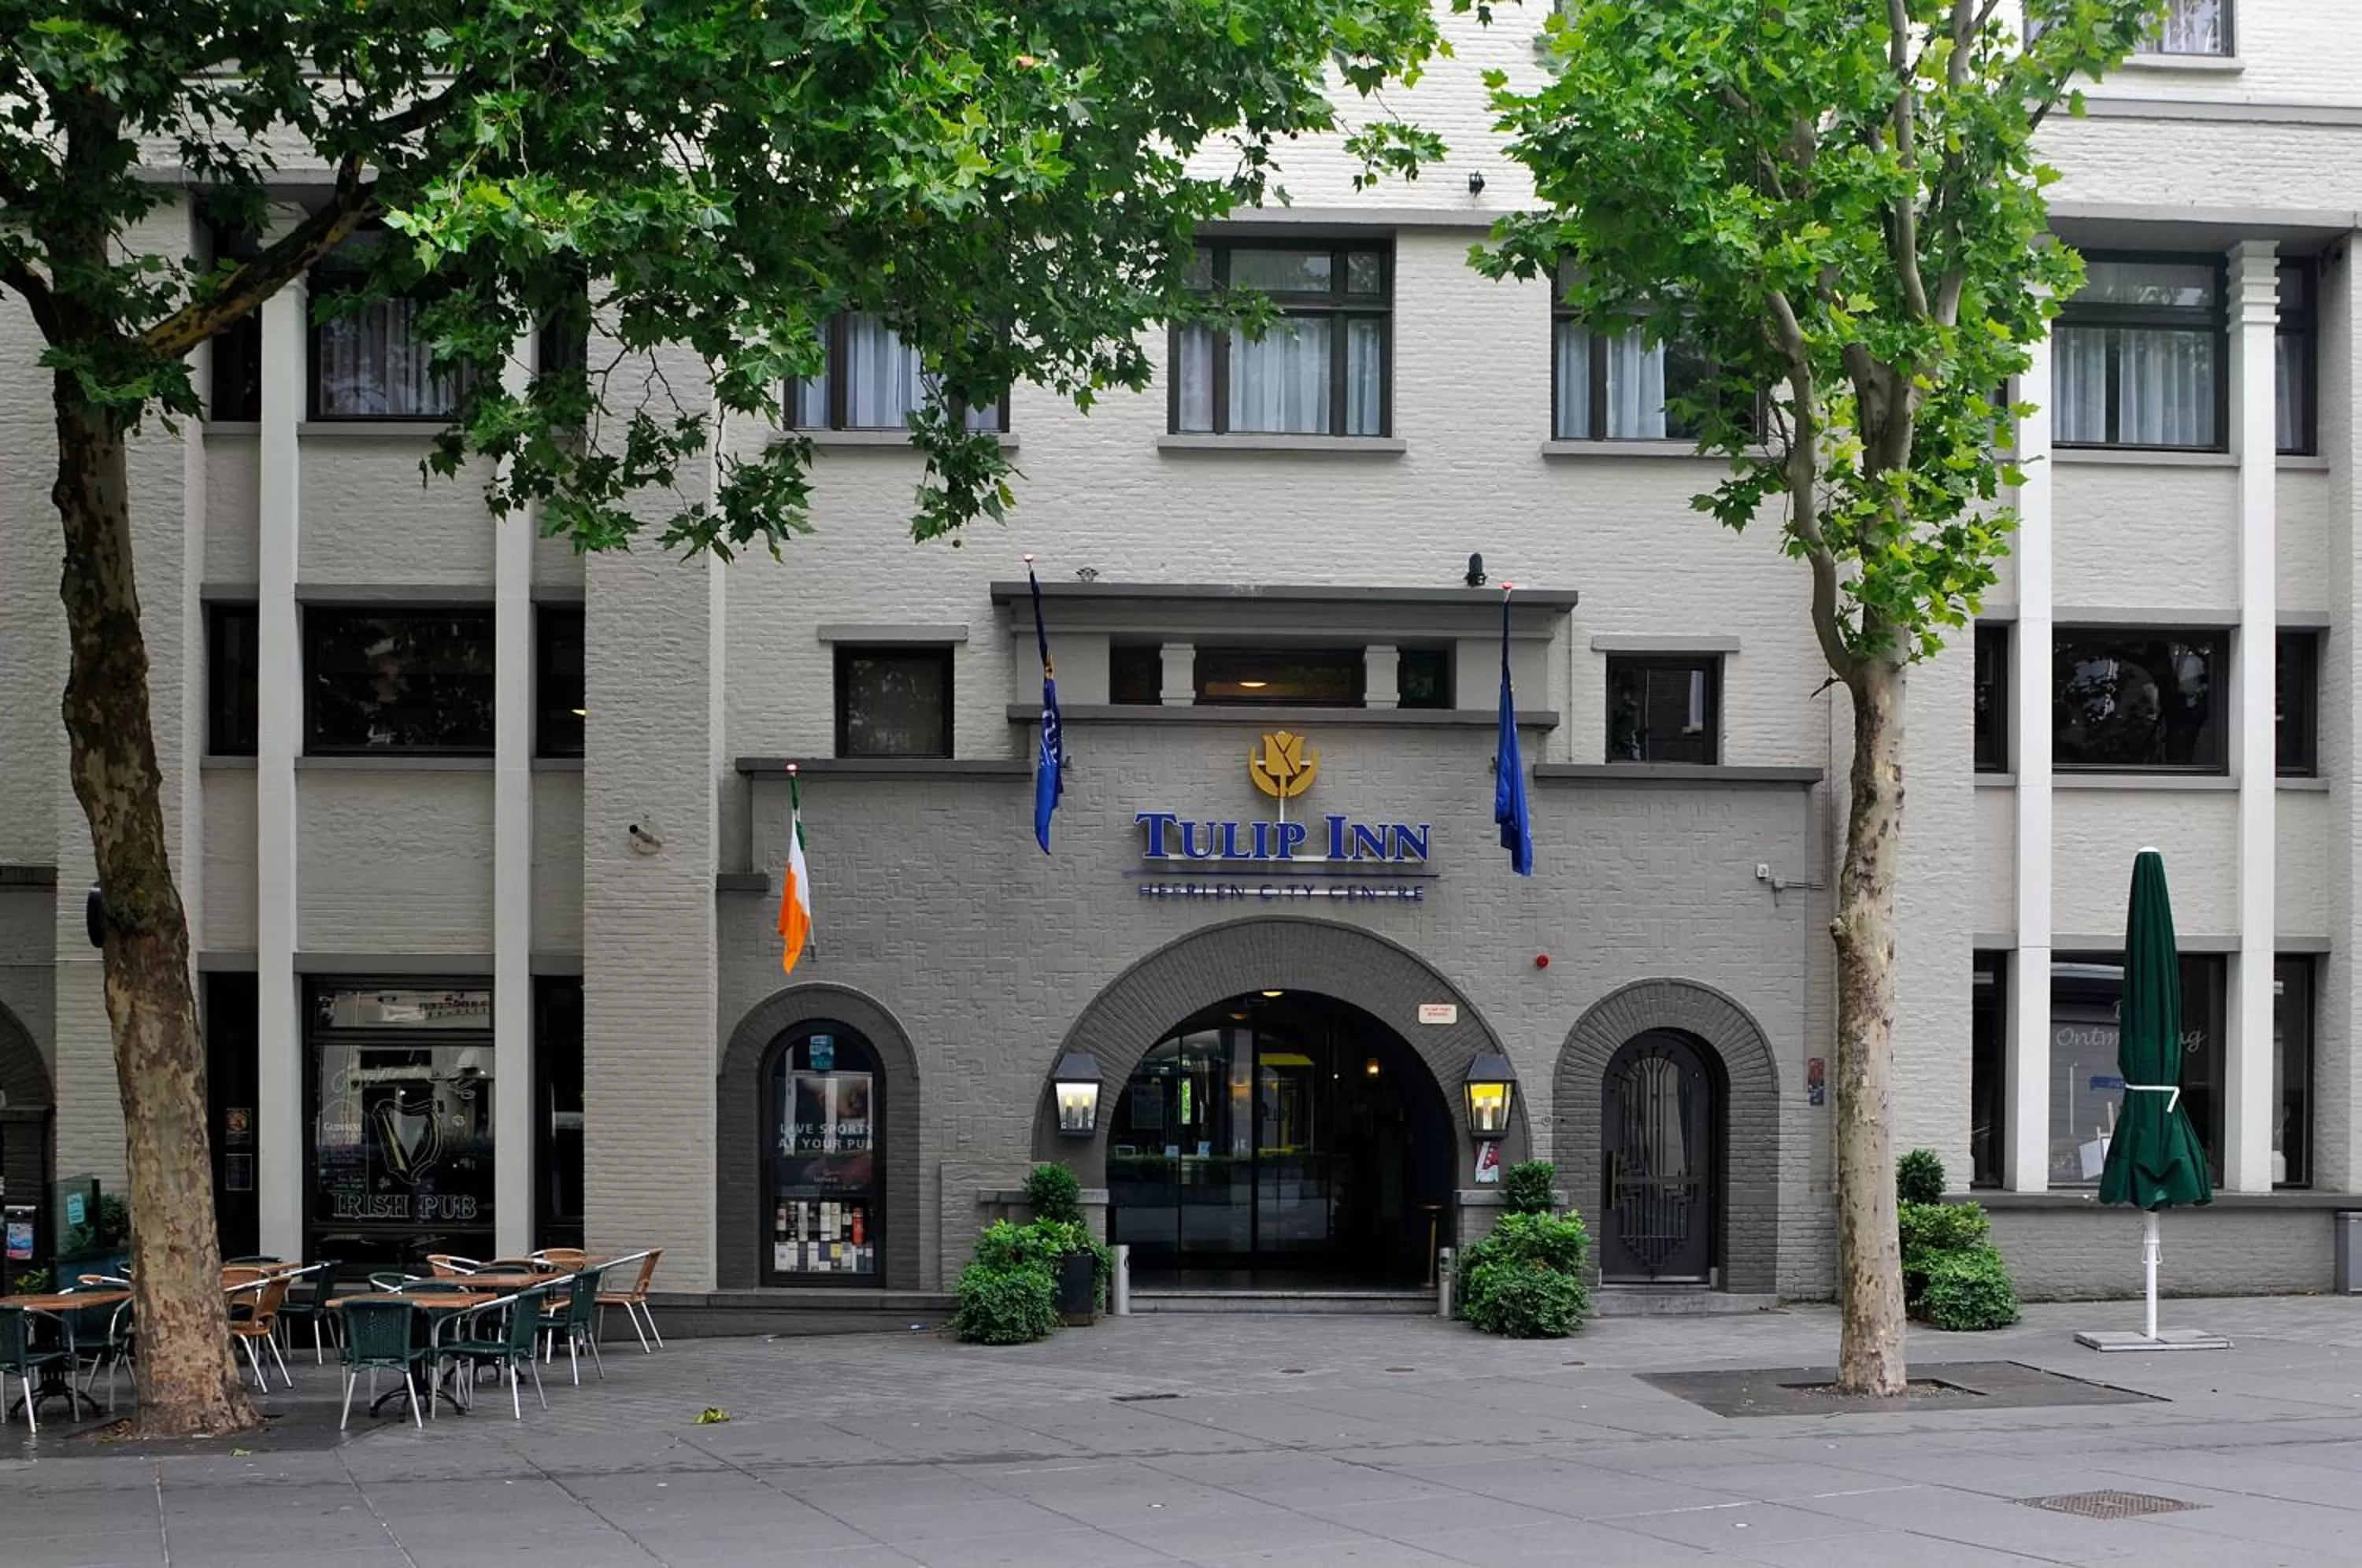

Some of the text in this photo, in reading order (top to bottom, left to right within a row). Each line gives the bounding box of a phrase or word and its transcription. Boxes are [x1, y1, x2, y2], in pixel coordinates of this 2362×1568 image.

[1134, 812, 1431, 862] TULIP INN
[1139, 882, 1424, 902] HEERLEN CITY CENTRE
[820, 1122, 873, 1134] SPORTS
[802, 1138, 842, 1149] YOUR
[846, 1138, 873, 1149] PUB
[331, 1193, 478, 1219] IRISH PUB
